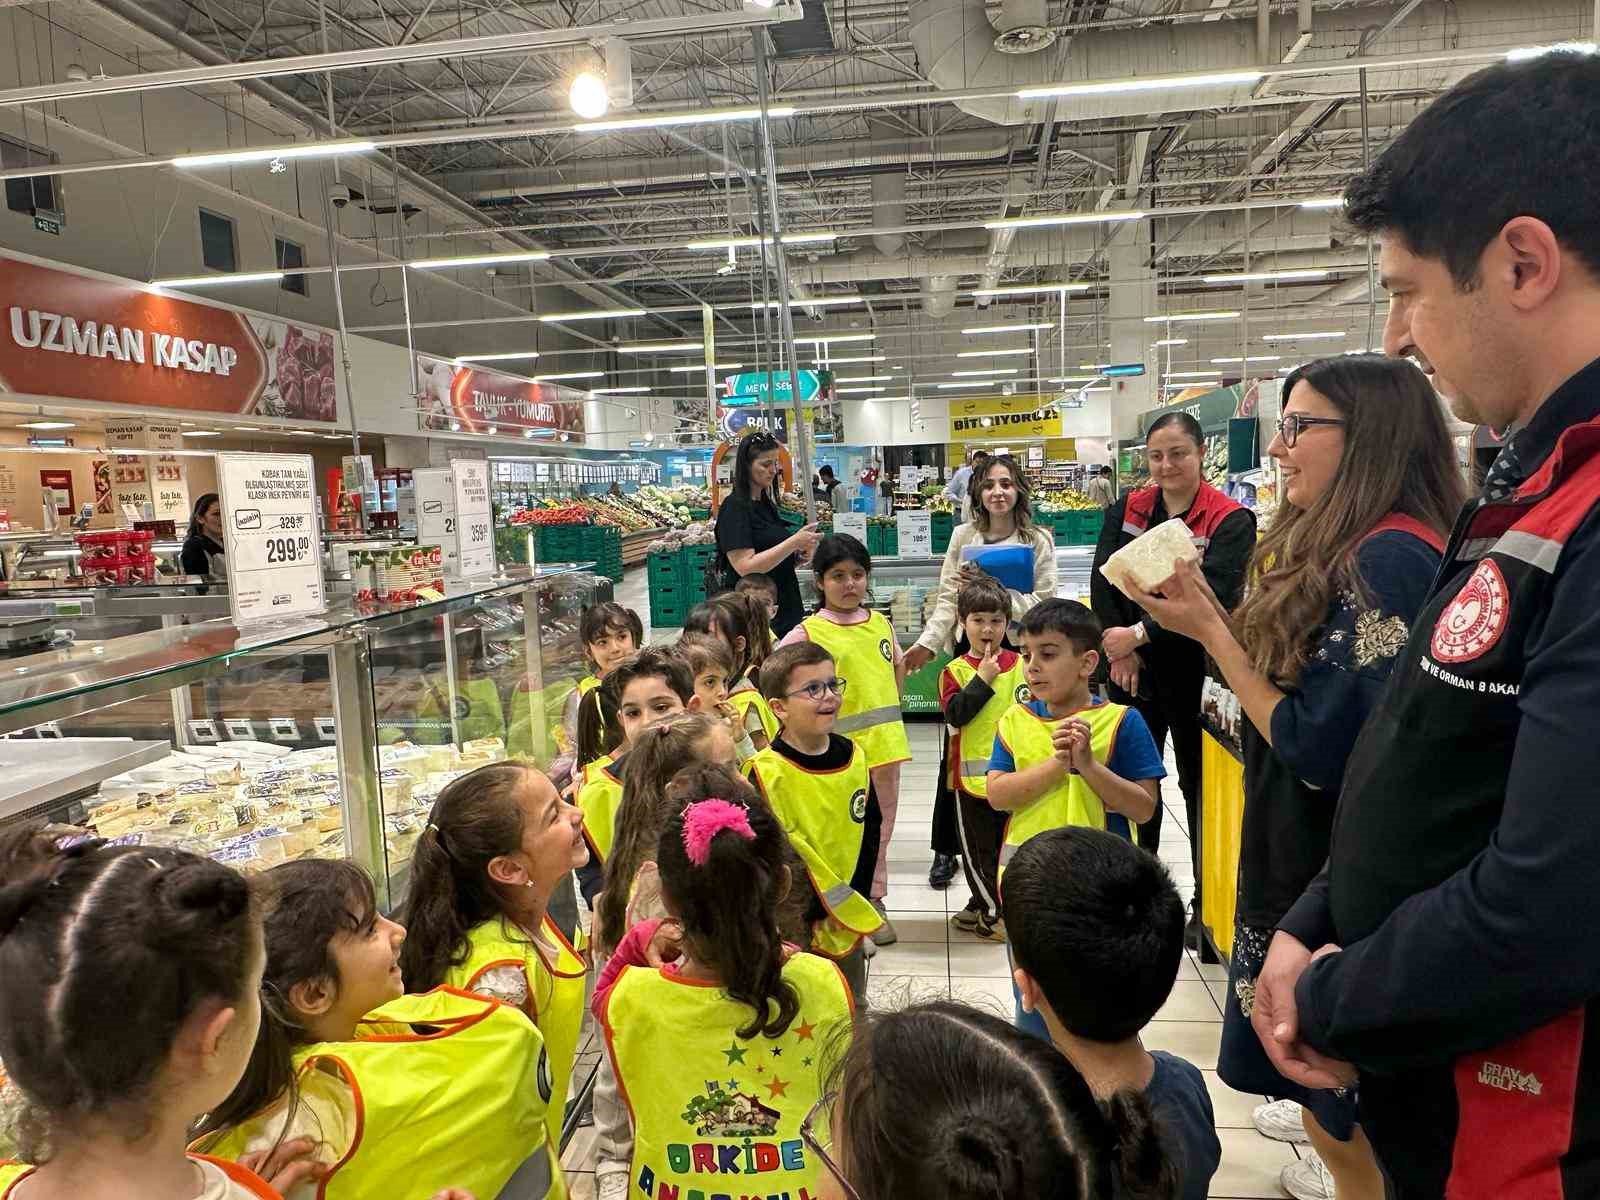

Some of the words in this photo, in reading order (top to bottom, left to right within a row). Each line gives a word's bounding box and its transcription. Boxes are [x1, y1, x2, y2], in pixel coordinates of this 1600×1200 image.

[10, 306, 146, 365] UZMAN
[151, 332, 238, 376] KASAP
[1440, 670, 1474, 690] ORMAN
[667, 1138, 805, 1174] ORKİDE
